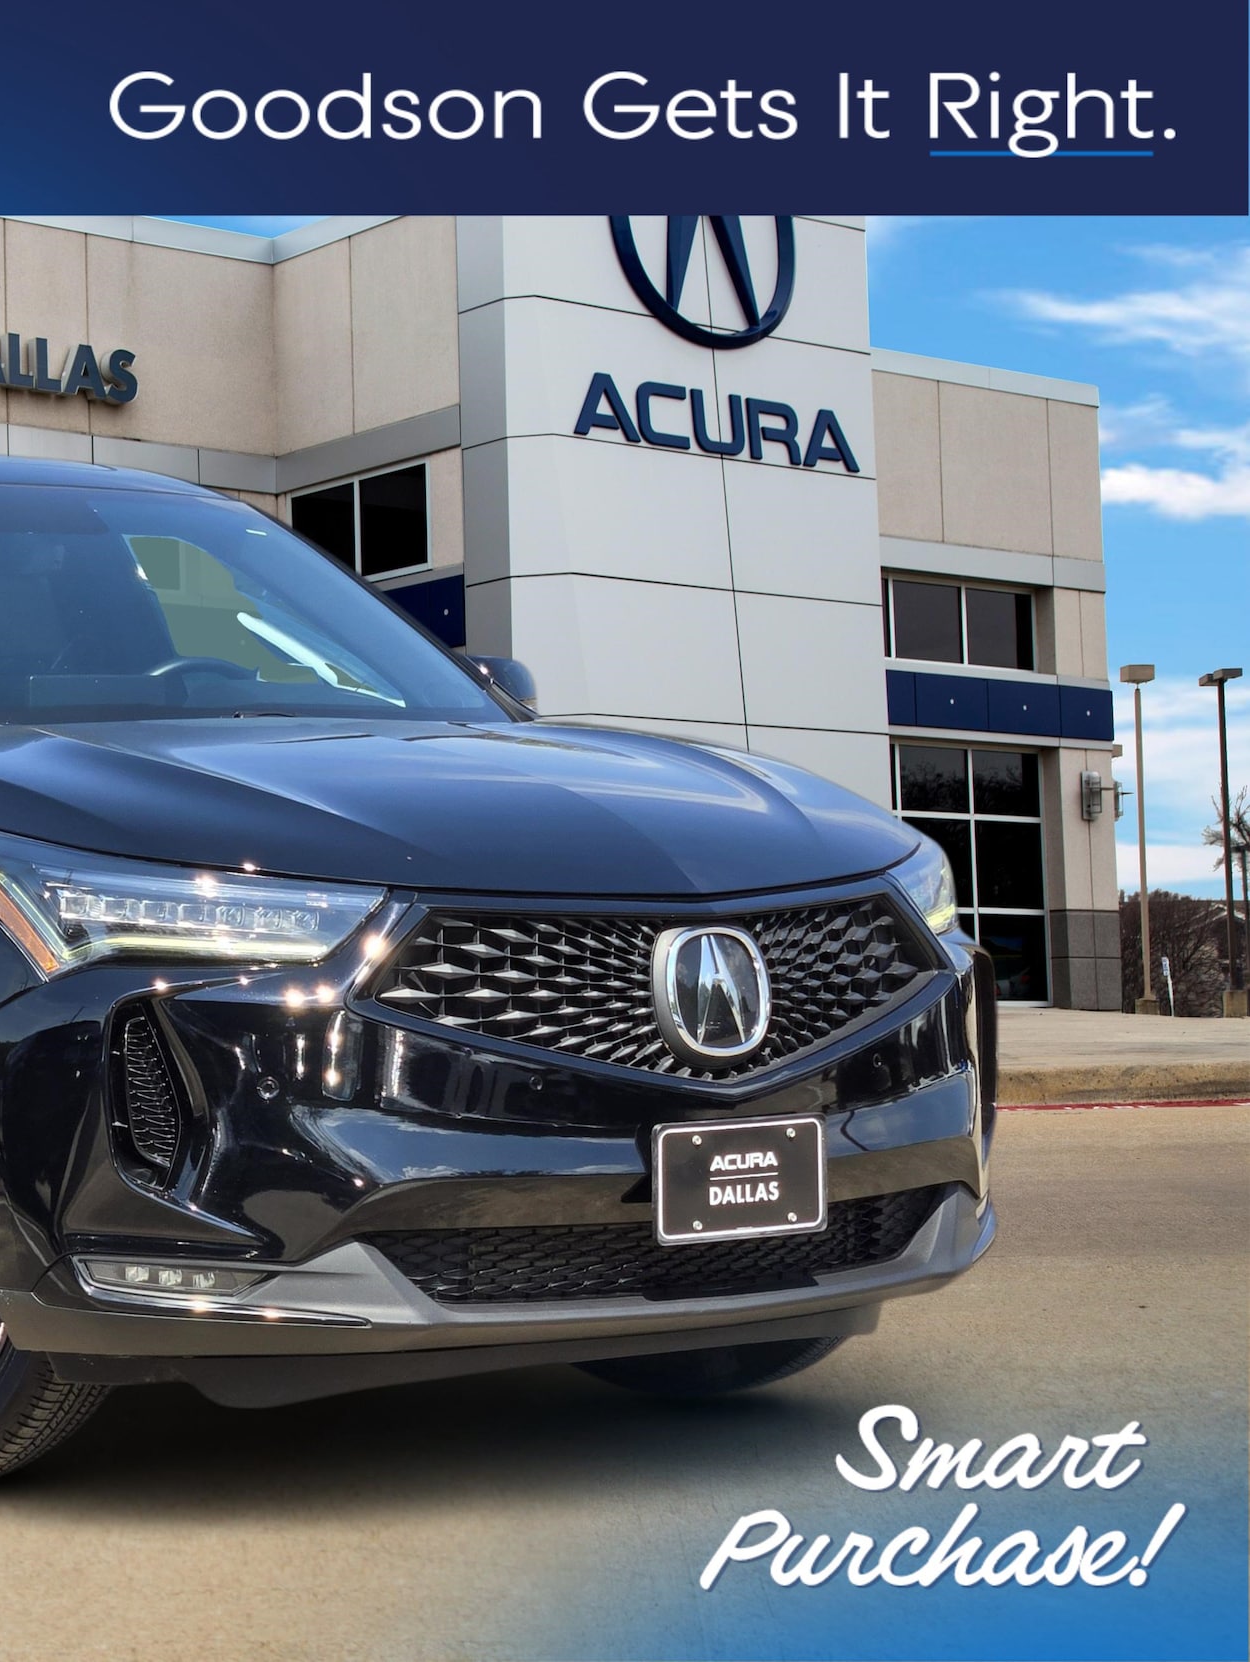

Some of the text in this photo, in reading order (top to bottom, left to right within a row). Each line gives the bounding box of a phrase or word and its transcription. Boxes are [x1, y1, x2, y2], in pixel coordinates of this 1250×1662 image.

[573, 372, 861, 474] ACURA
[709, 1151, 779, 1172] ACURA
[709, 1181, 780, 1206] DALLAS
